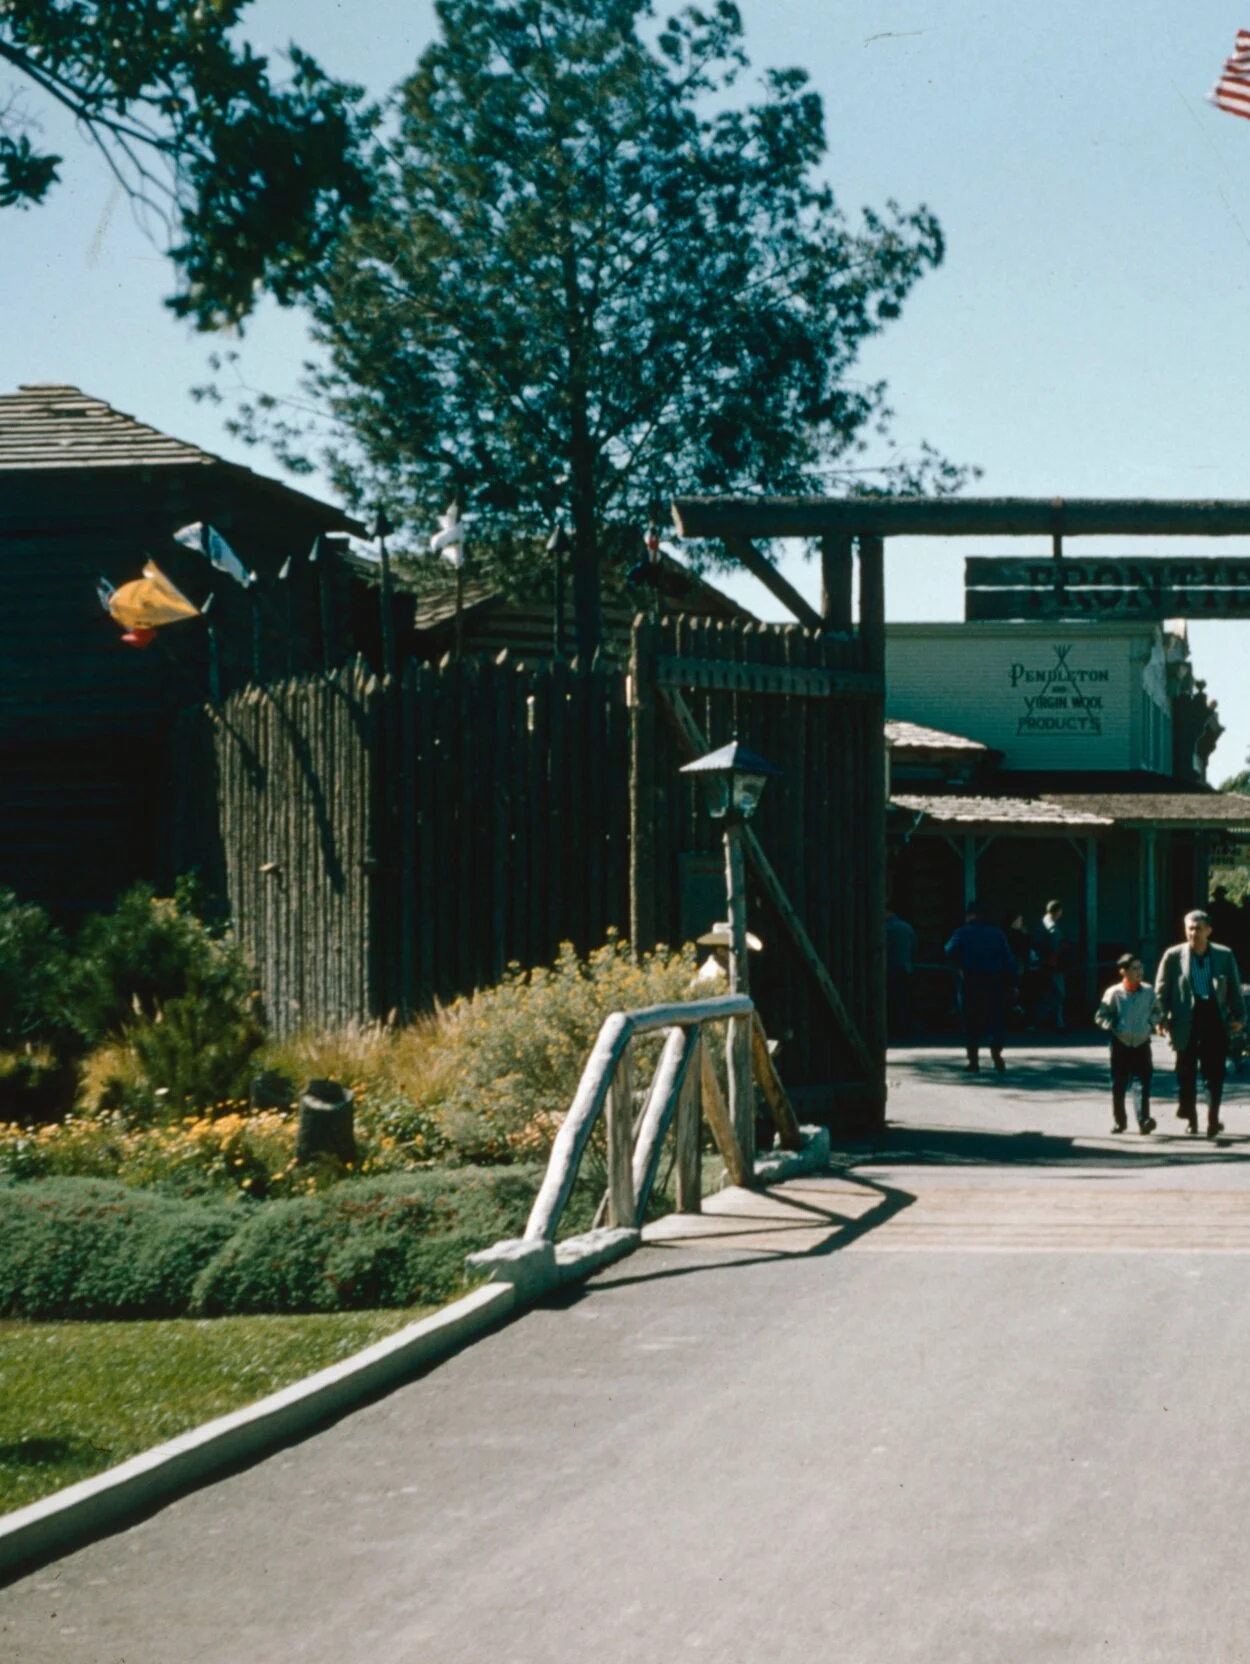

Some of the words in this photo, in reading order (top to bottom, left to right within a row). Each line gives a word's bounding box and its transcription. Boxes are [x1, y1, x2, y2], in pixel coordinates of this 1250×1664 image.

[1008, 663, 1110, 688] PENDLETON
[1024, 695, 1068, 709] VIRGIN
[1071, 695, 1104, 710] WOOL
[1018, 716, 1102, 731] PRODUCTS
